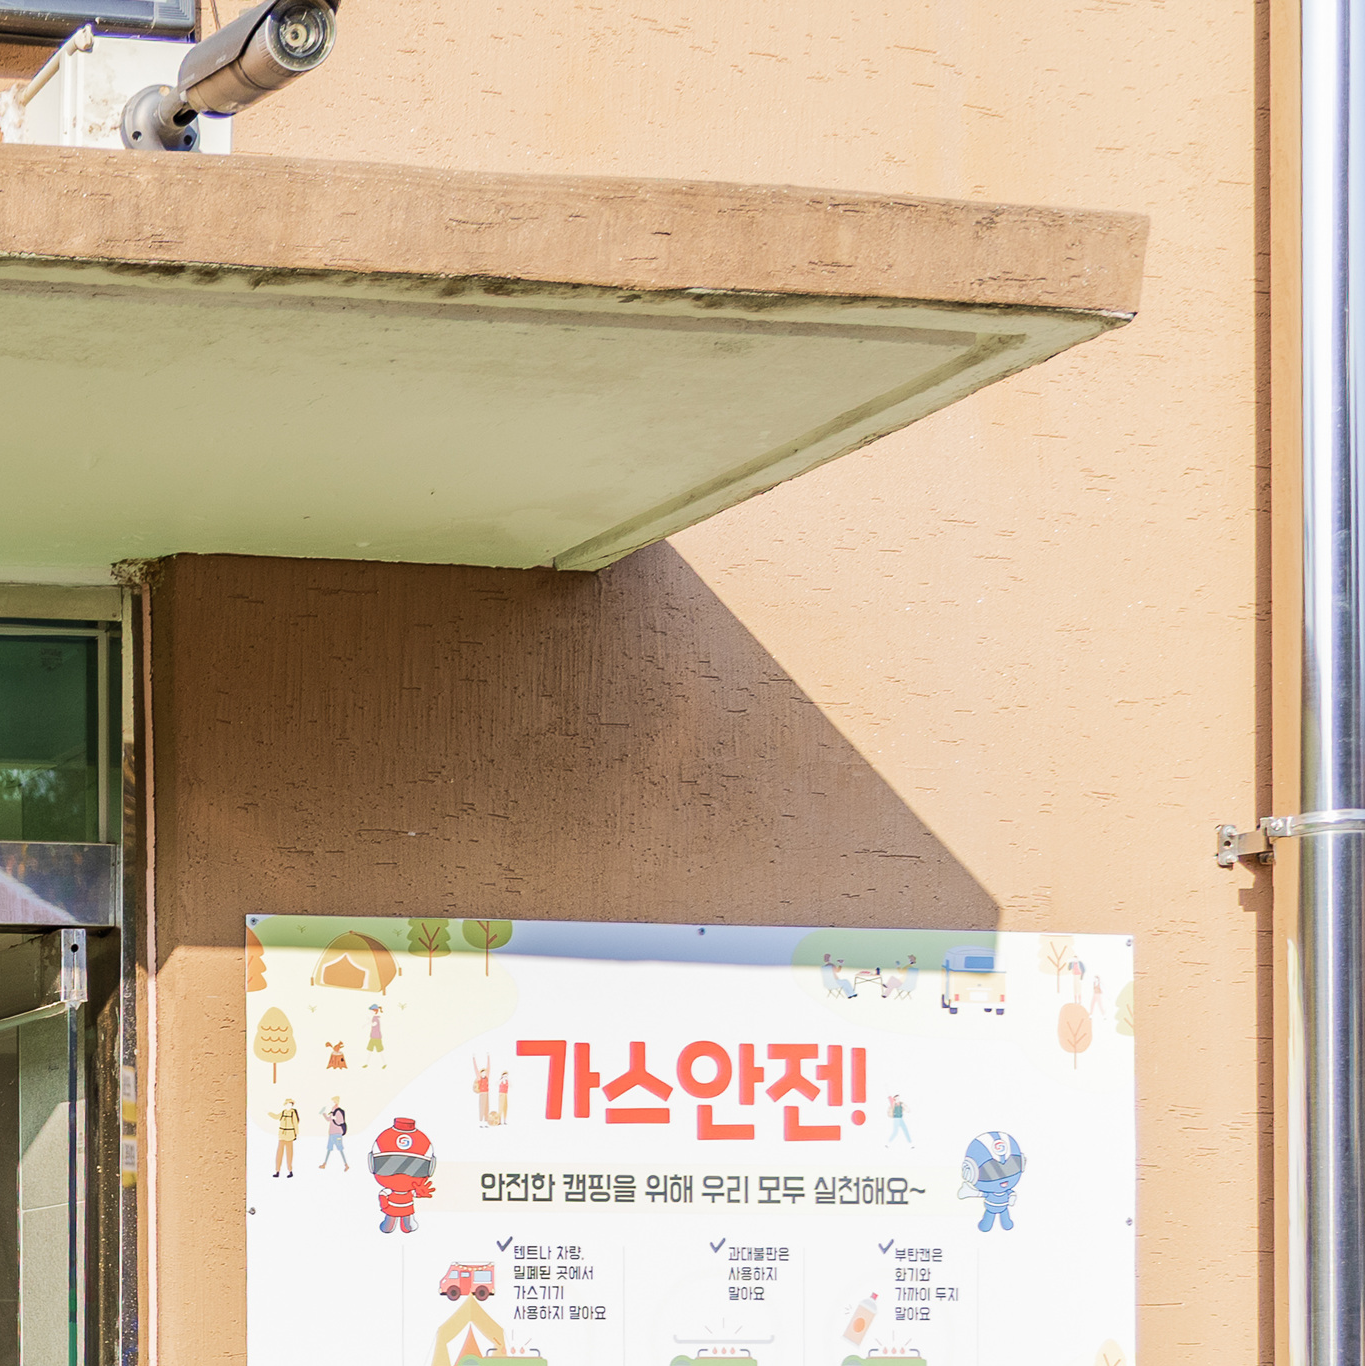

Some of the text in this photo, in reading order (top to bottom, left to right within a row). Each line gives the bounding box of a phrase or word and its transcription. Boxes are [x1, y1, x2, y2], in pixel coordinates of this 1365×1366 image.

[515, 1038, 869, 1142] 가스안전!
[480, 1172, 926, 1205] 안전한 캠핑을 위해 우리 모두 실천해요~
[513, 1245, 552, 1260] 텐트나
[727, 1246, 791, 1262] 과대불판은
[894, 1247, 943, 1263] 부탄캔은
[513, 1265, 594, 1280] 밀폐된 곳에서
[727, 1266, 777, 1281] 사용하지
[894, 1267, 931, 1282] 화기와
[513, 1285, 564, 1300] 가스기기
[727, 1286, 765, 1301] 말아요
[894, 1287, 960, 1302] 가까이 두지
[513, 1305, 607, 1320] 사용하지 말아요
[894, 1306, 931, 1321] 말아요
